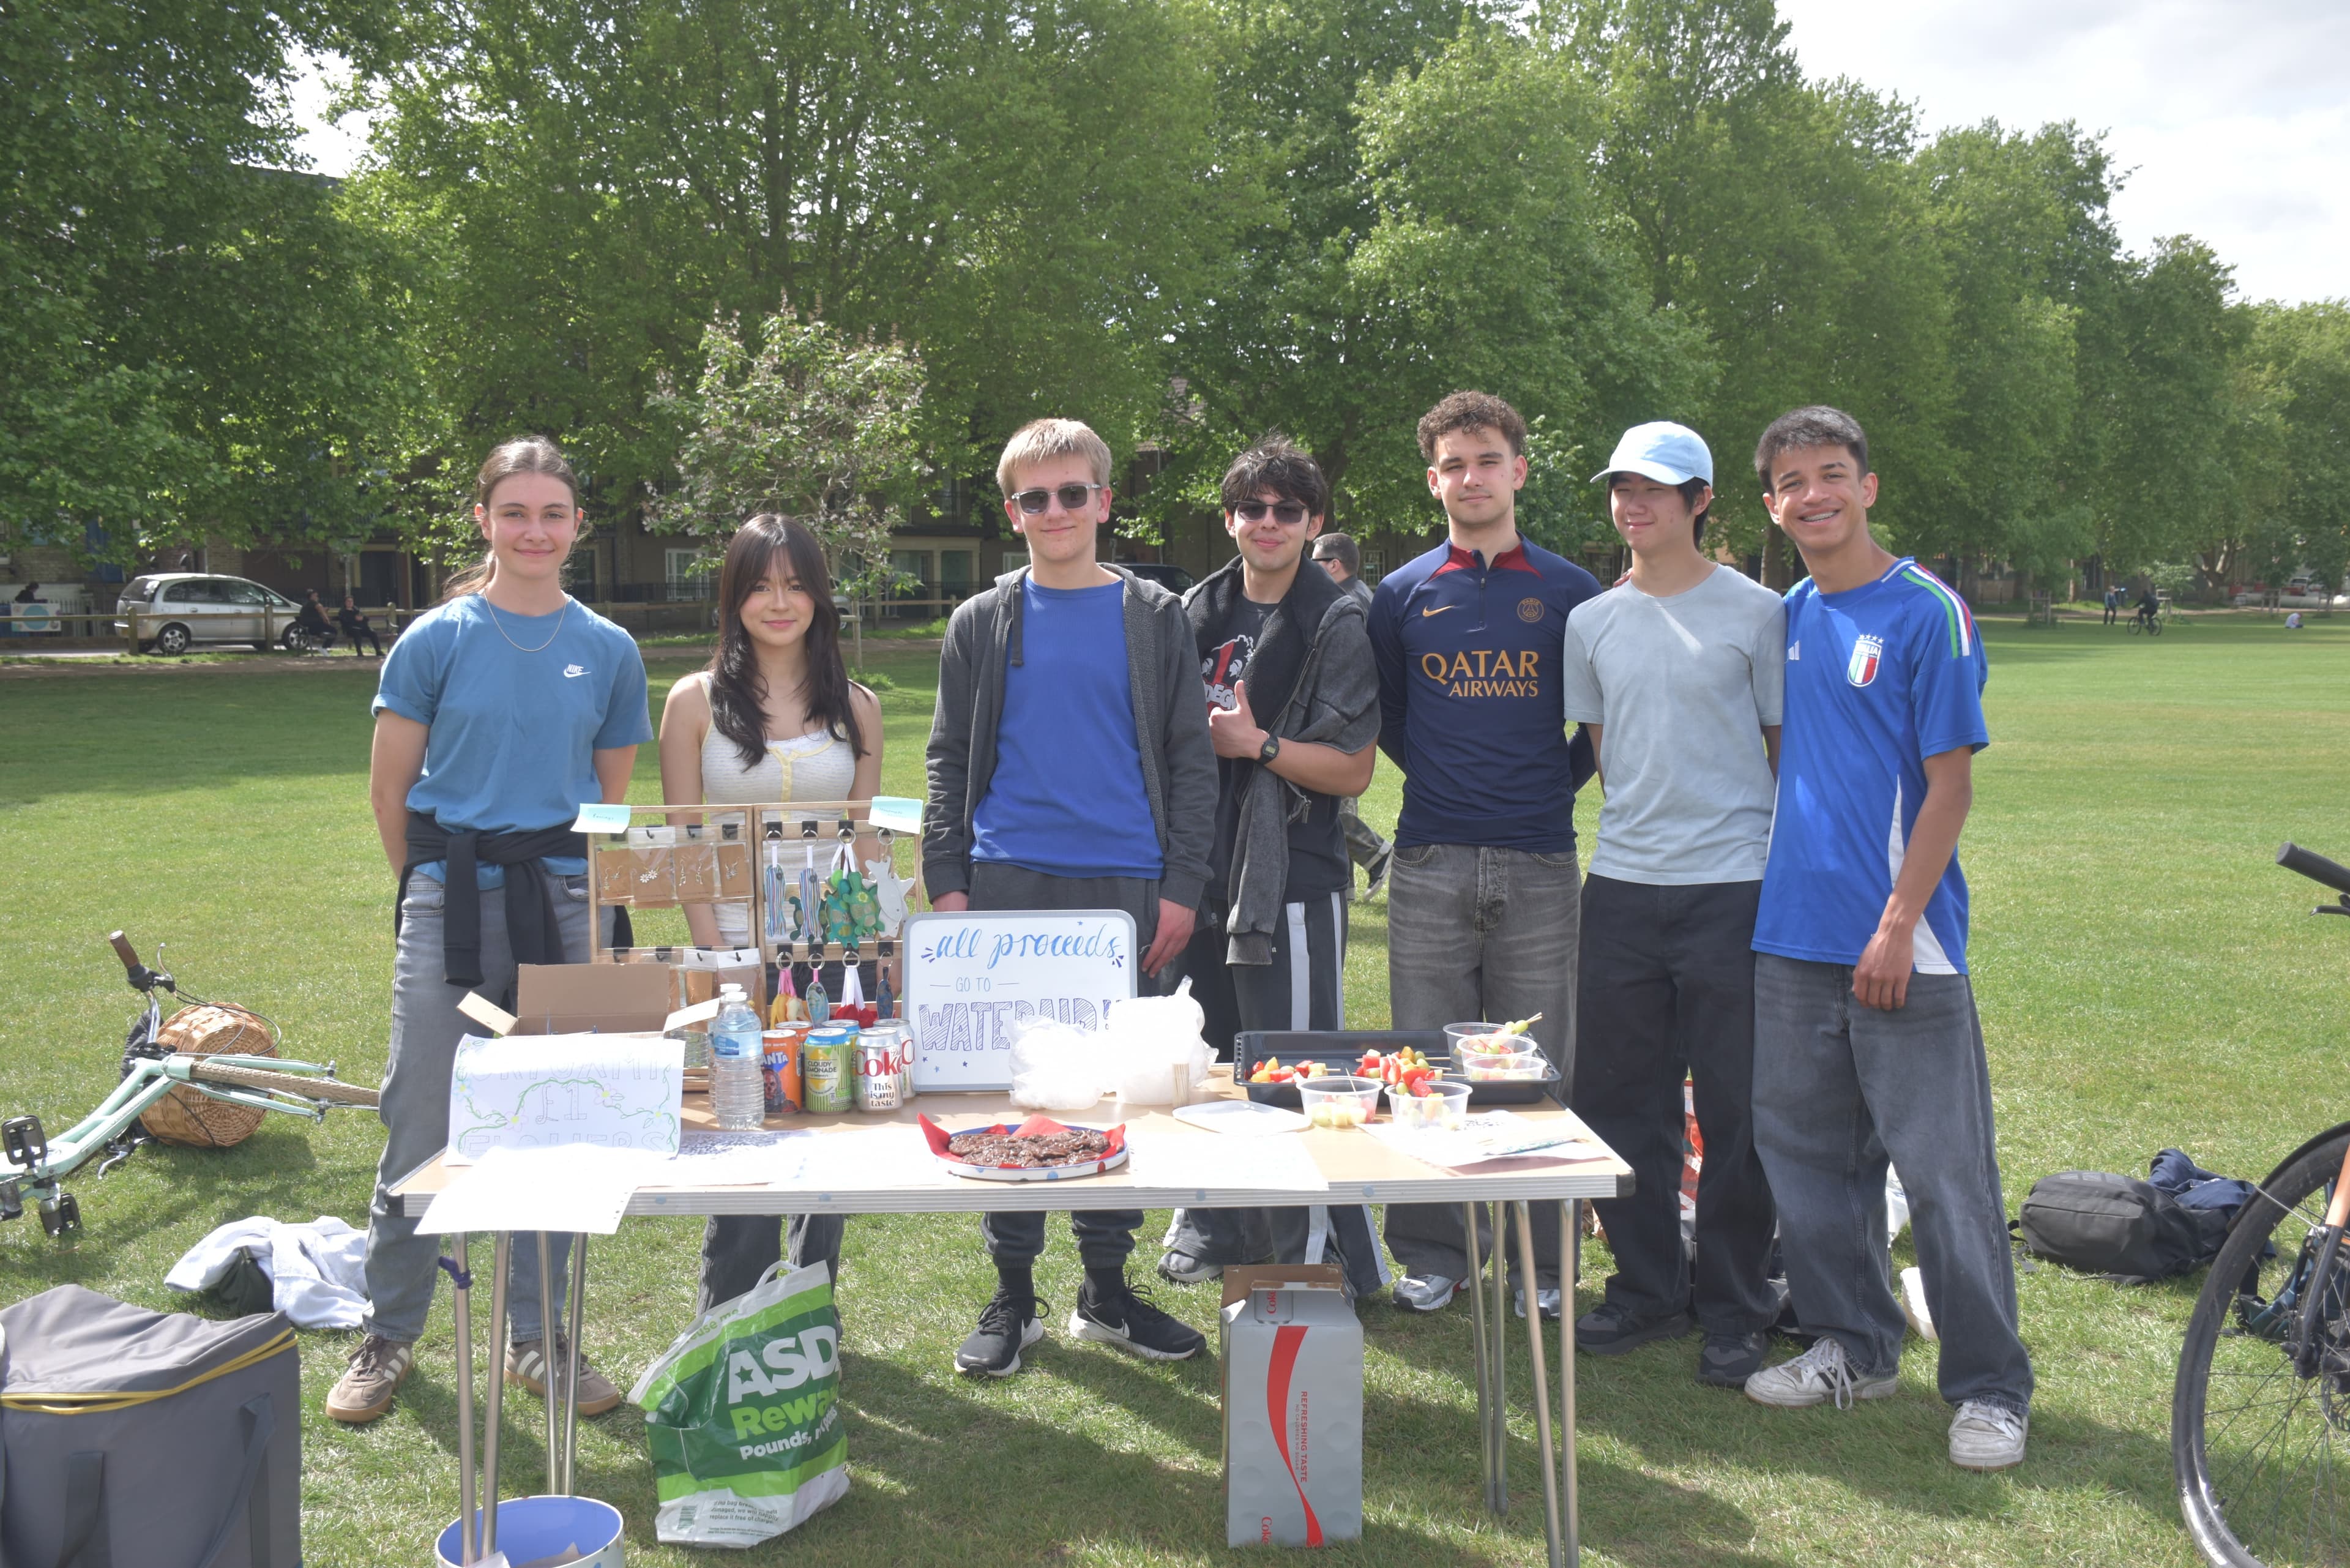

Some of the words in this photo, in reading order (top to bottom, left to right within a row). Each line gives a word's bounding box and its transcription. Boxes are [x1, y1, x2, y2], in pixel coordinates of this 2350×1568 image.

[567, 663, 584, 674] NIKE
[1422, 650, 1539, 685] QATAR
[1449, 680, 1539, 697] AIRWAYS
[936, 927, 982, 958] all
[987, 924, 1122, 970] proceeds
[955, 977, 971, 992] GO
[975, 977, 991, 992] TO
[761, 1051, 788, 1066] ANTA
[856, 1050, 902, 1077] Coke
[535, 1081, 588, 1125] £1
[870, 1091, 878, 1099] is
[690, 1320, 718, 1340] euse
[728, 1325, 839, 1404] ASD
[730, 1383, 839, 1441] Rewa
[740, 1430, 812, 1461] Pounds,
[1261, 1517, 1274, 1544] Coke
